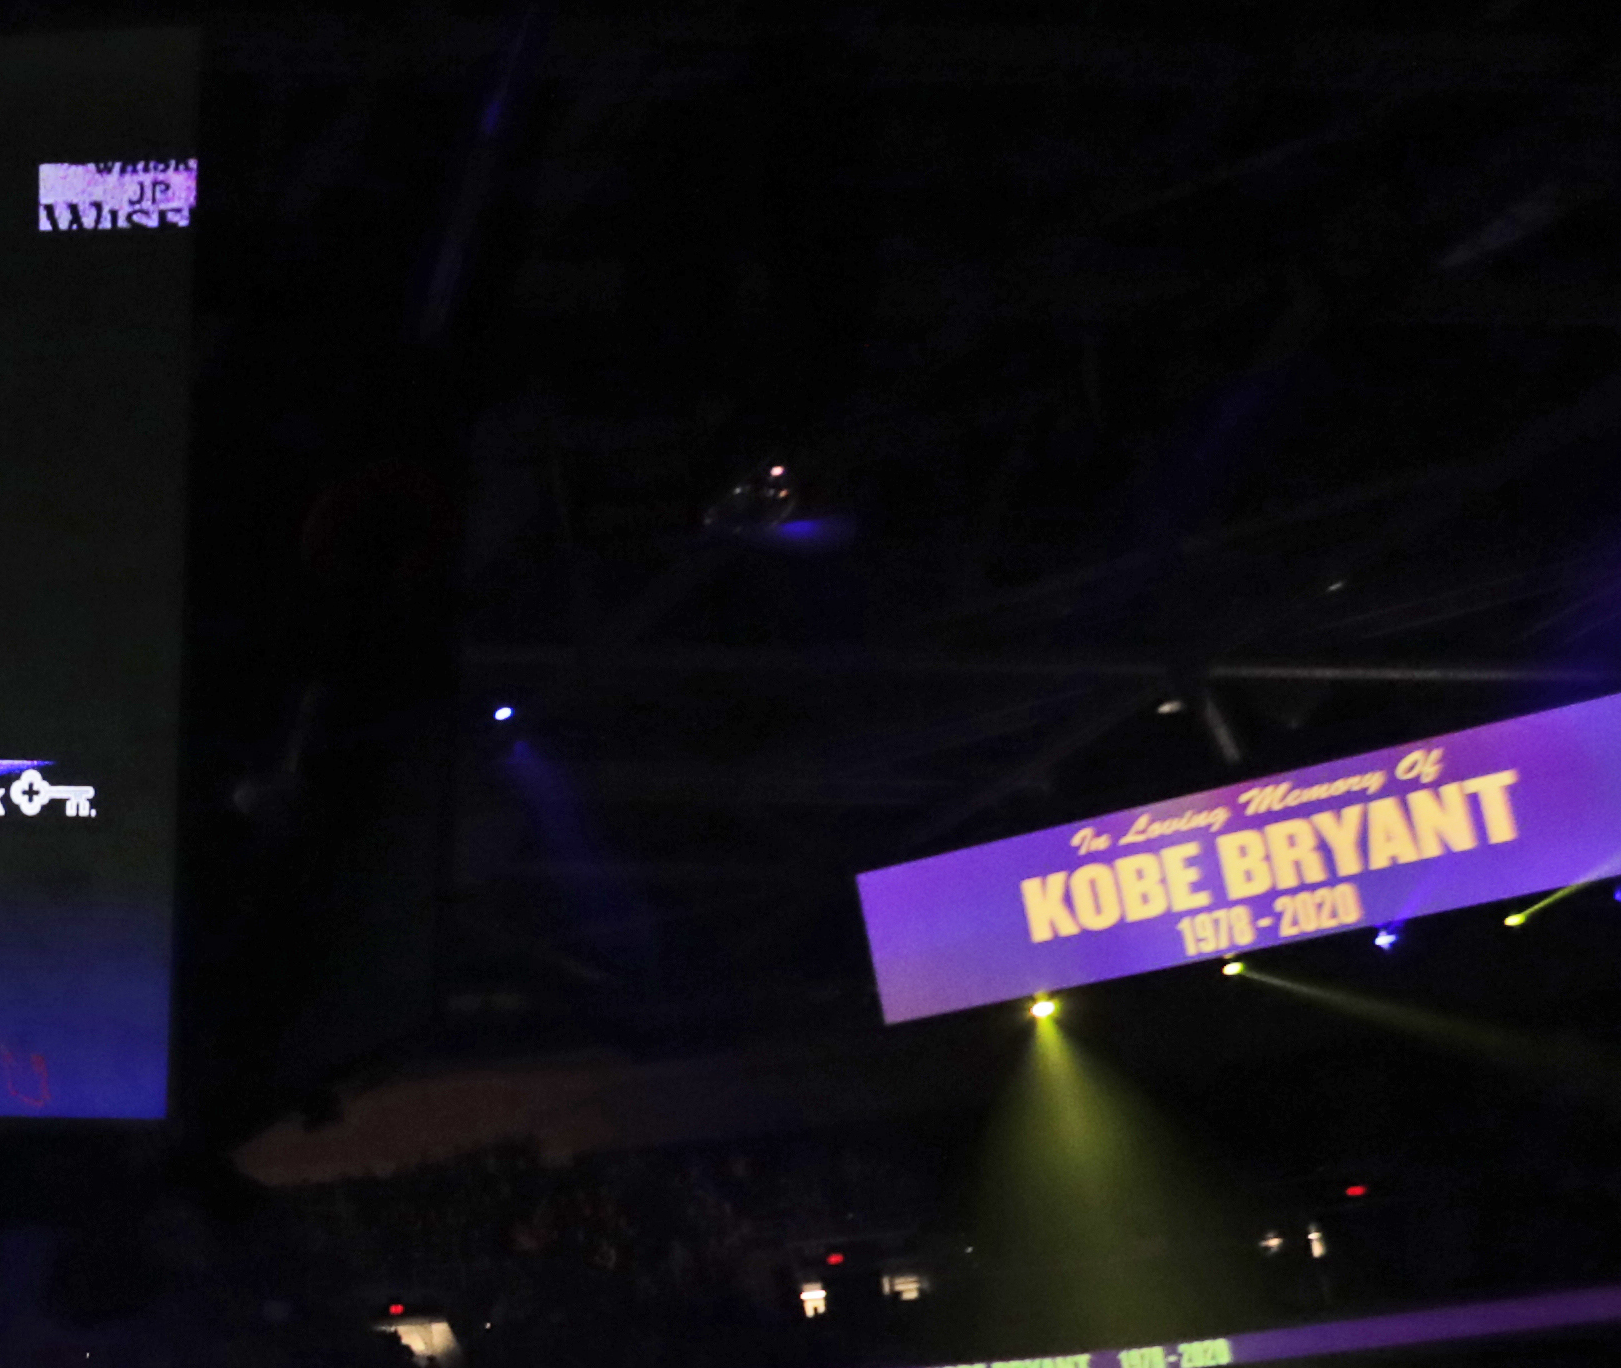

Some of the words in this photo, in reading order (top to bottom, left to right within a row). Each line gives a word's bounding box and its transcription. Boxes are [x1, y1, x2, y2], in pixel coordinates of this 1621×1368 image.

[1071, 828, 1111, 855] In
[1119, 804, 1230, 846] Loving
[1238, 774, 1384, 817] Memory
[1394, 747, 1444, 785] Of
[1021, 840, 1211, 943] KOBE
[1217, 768, 1519, 899] BRYANT
[1177, 904, 1253, 956] 1978
[1274, 883, 1362, 938] 2020
